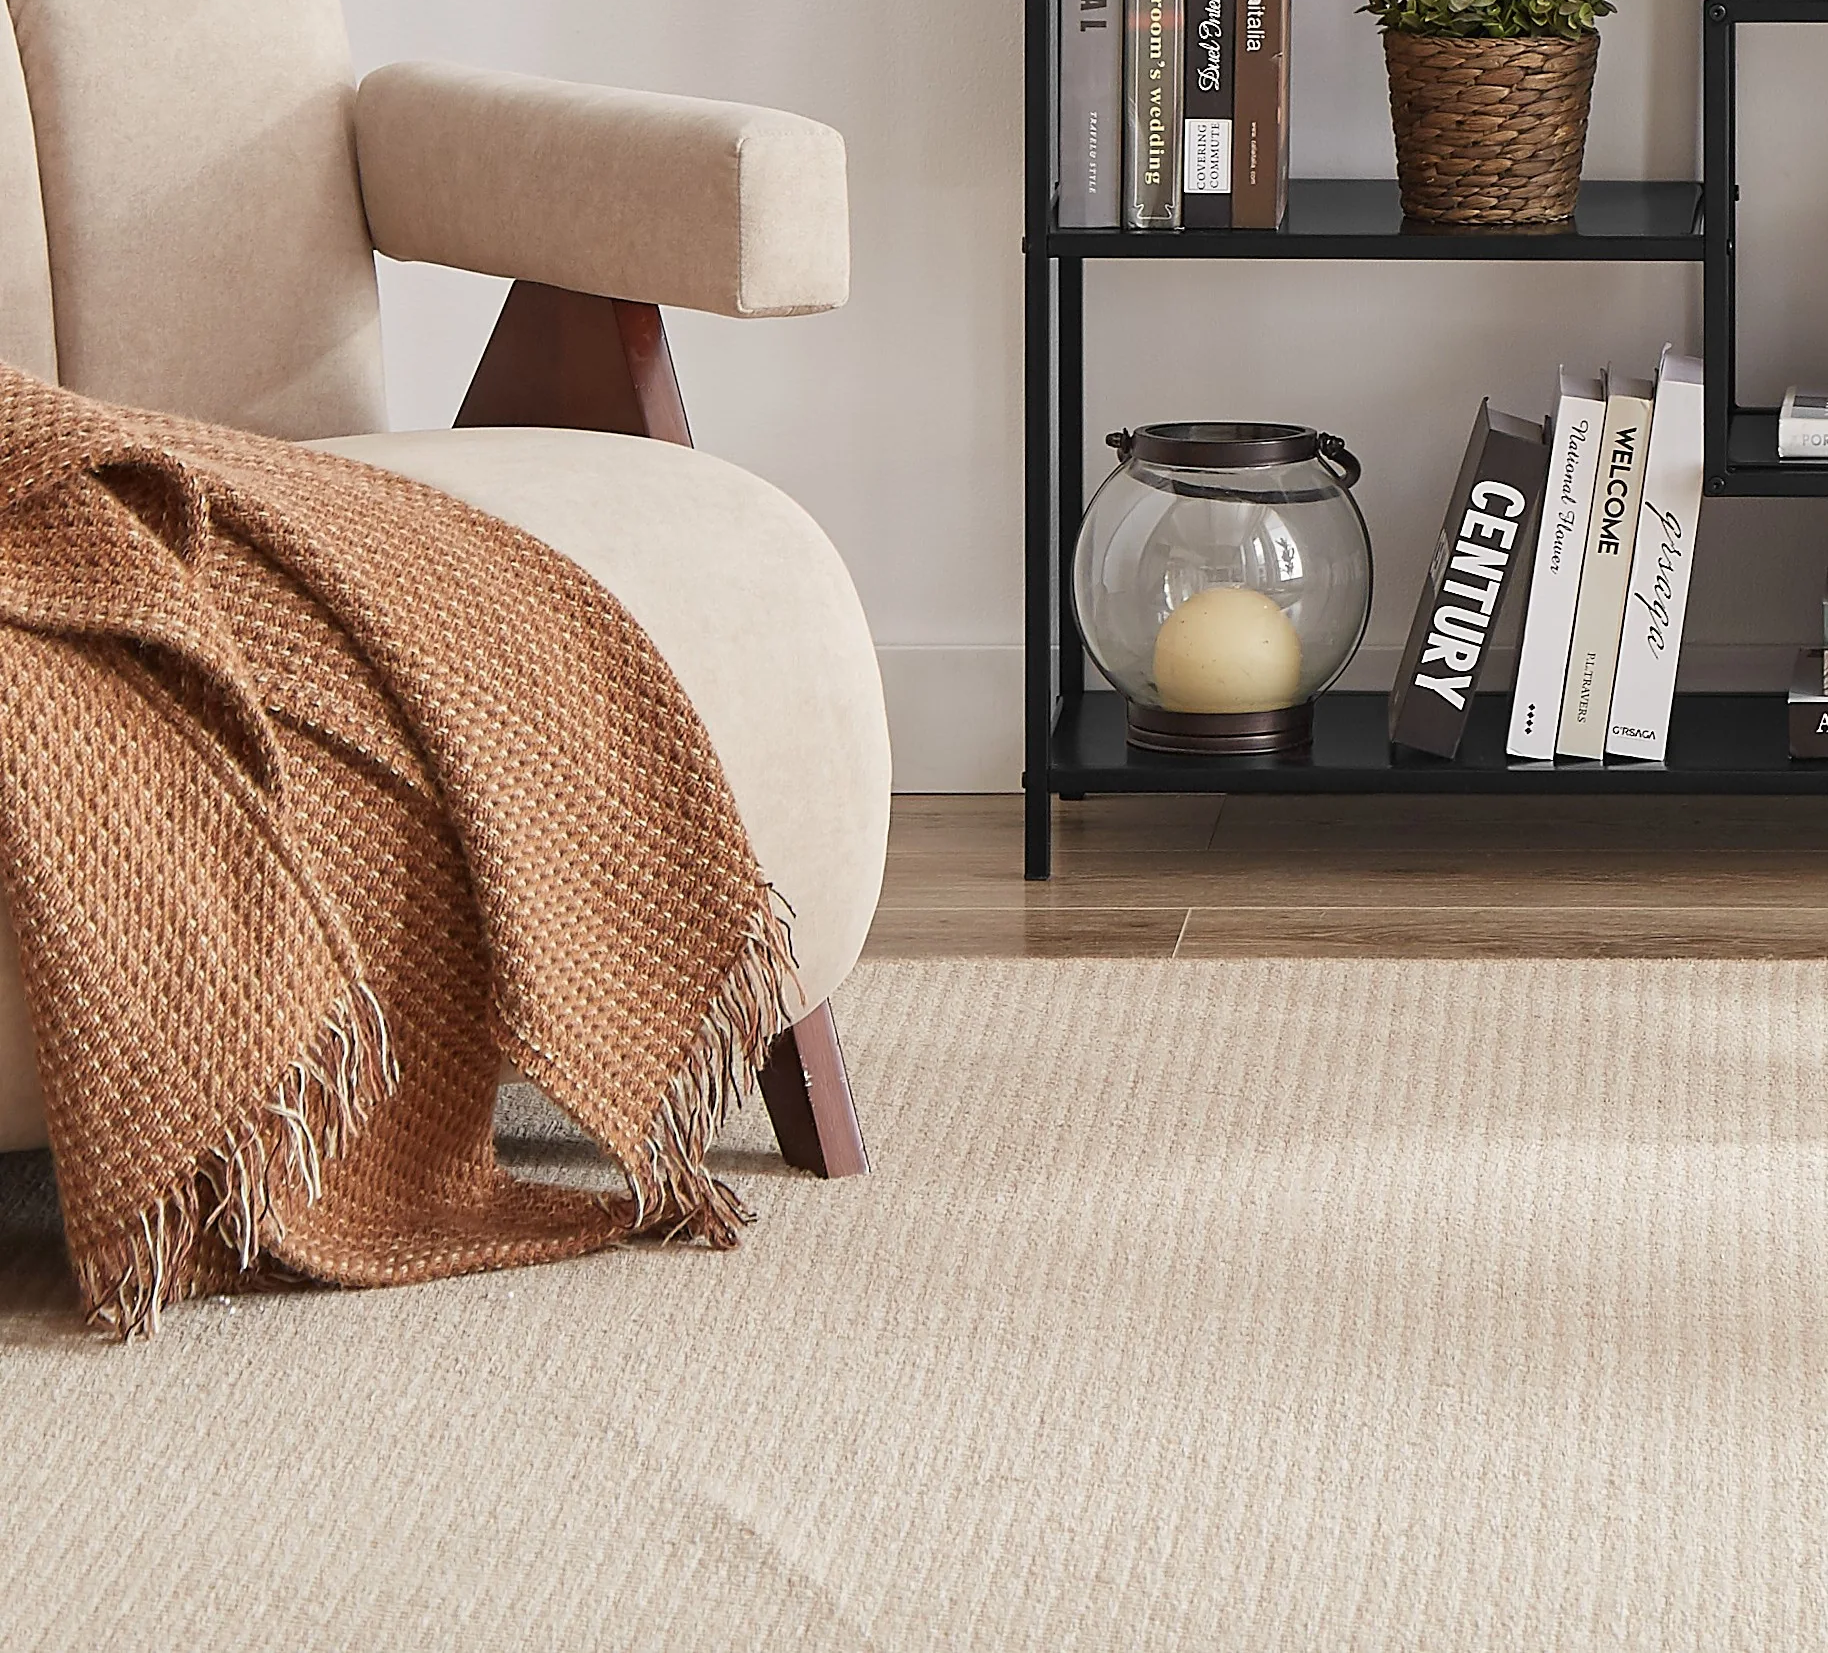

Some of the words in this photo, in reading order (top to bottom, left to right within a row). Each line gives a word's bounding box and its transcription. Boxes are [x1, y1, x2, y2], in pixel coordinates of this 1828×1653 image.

[1089, 162, 1097, 194] STYLE
[1145, 87, 1165, 185] wedding
[1197, 124, 1207, 190] COVERING
[1210, 122, 1220, 189] COMMUTE
[1560, 420, 1589, 505] National
[1597, 426, 1638, 556] WELCOME
[1414, 479, 1526, 711] CENTURY
